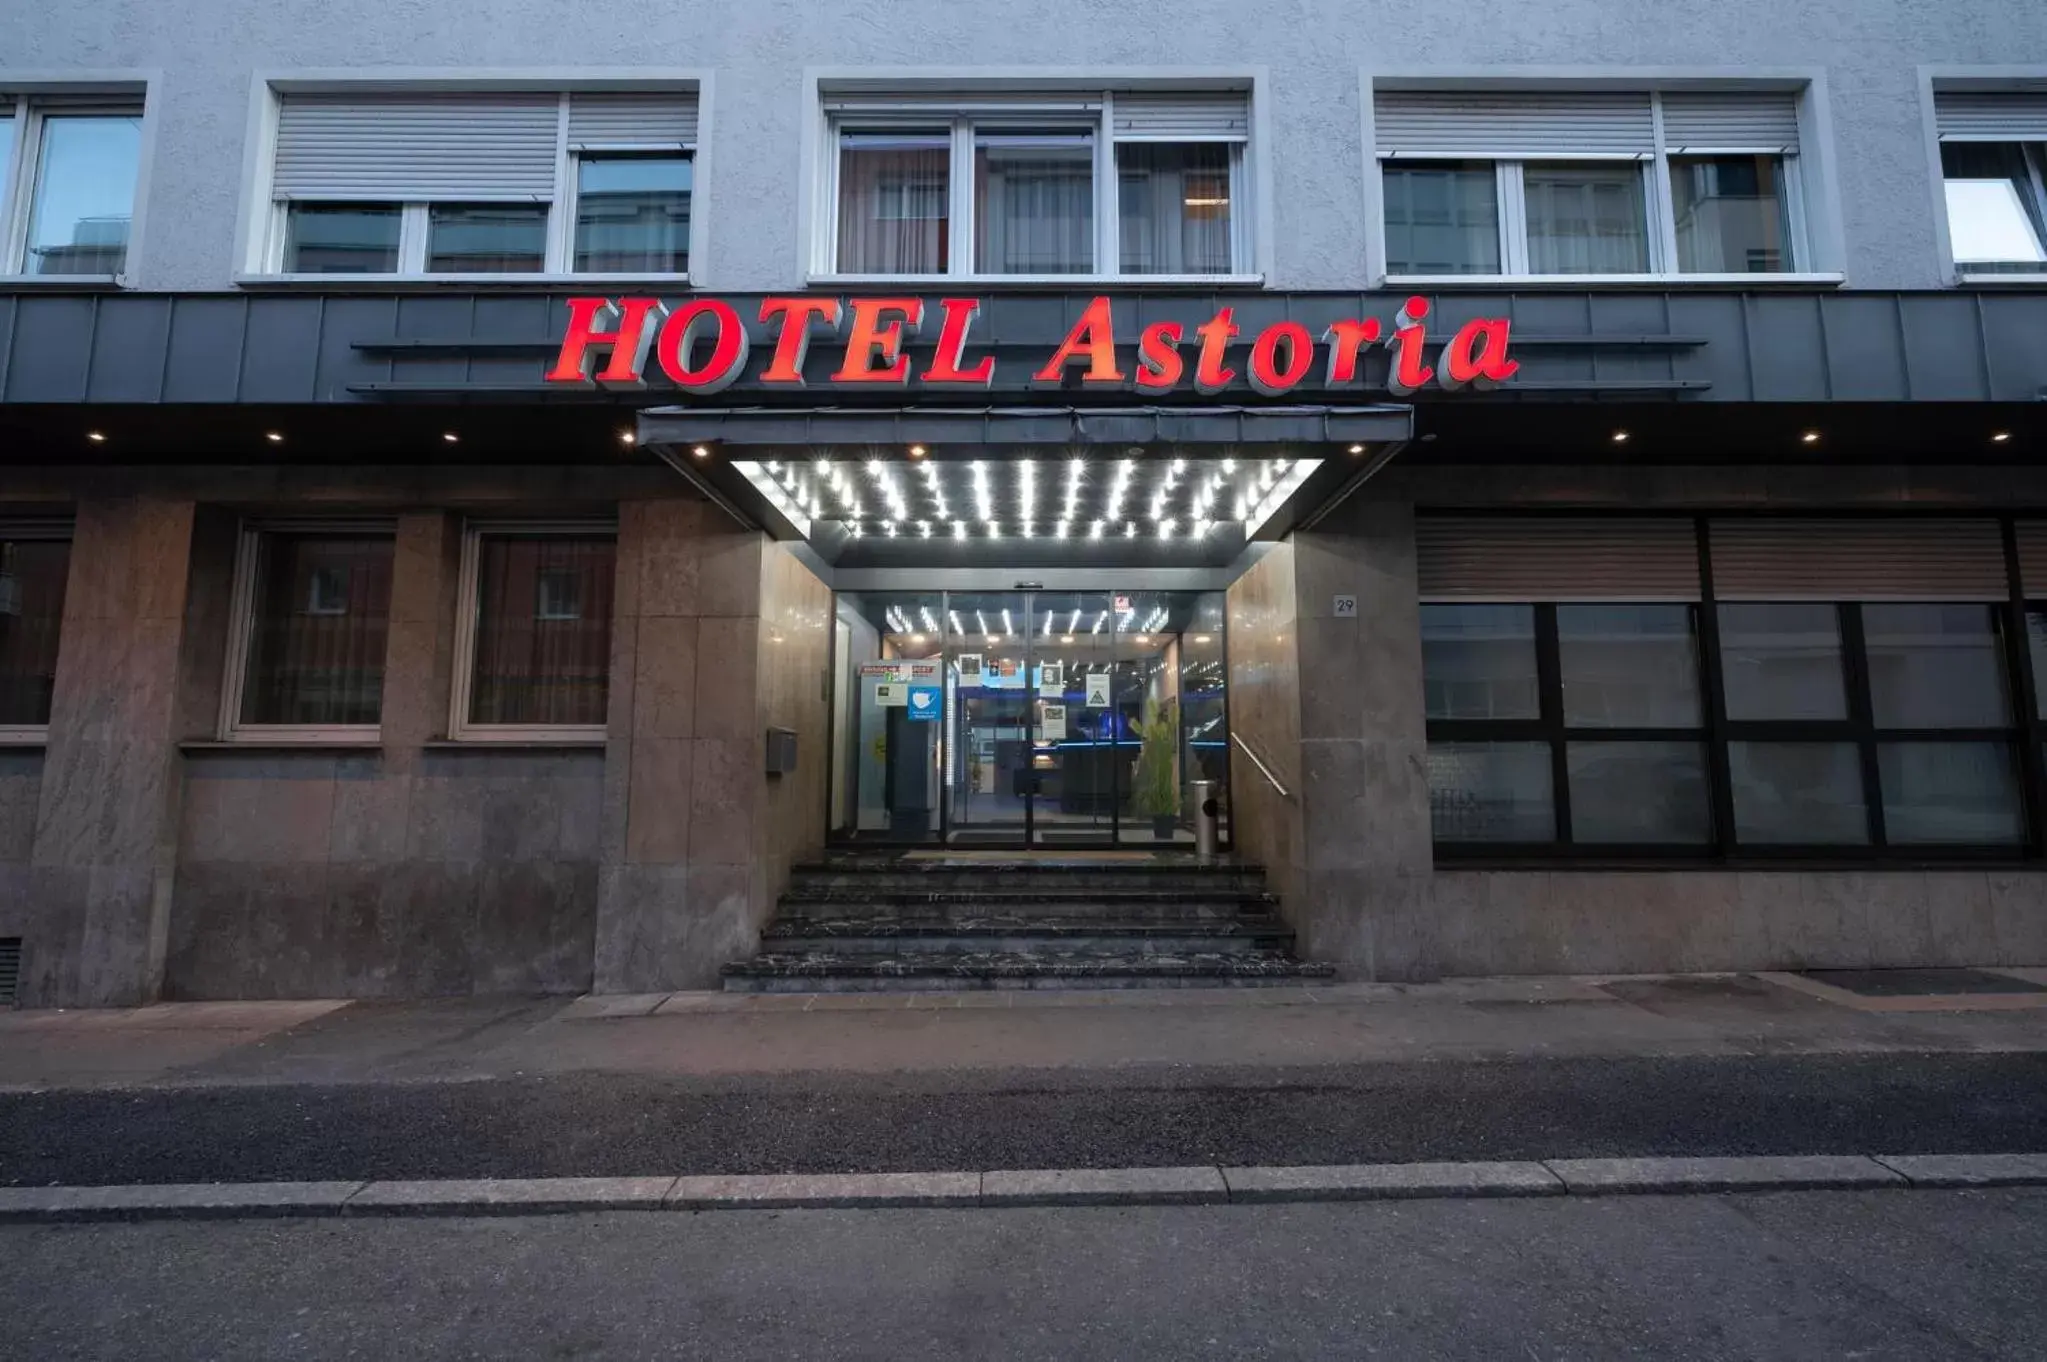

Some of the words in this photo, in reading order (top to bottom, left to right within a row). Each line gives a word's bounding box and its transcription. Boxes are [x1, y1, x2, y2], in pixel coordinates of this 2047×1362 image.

[545, 297, 996, 391] HOTEL
[1031, 295, 1520, 392] Astoria
[1336, 599, 1354, 612] 29
